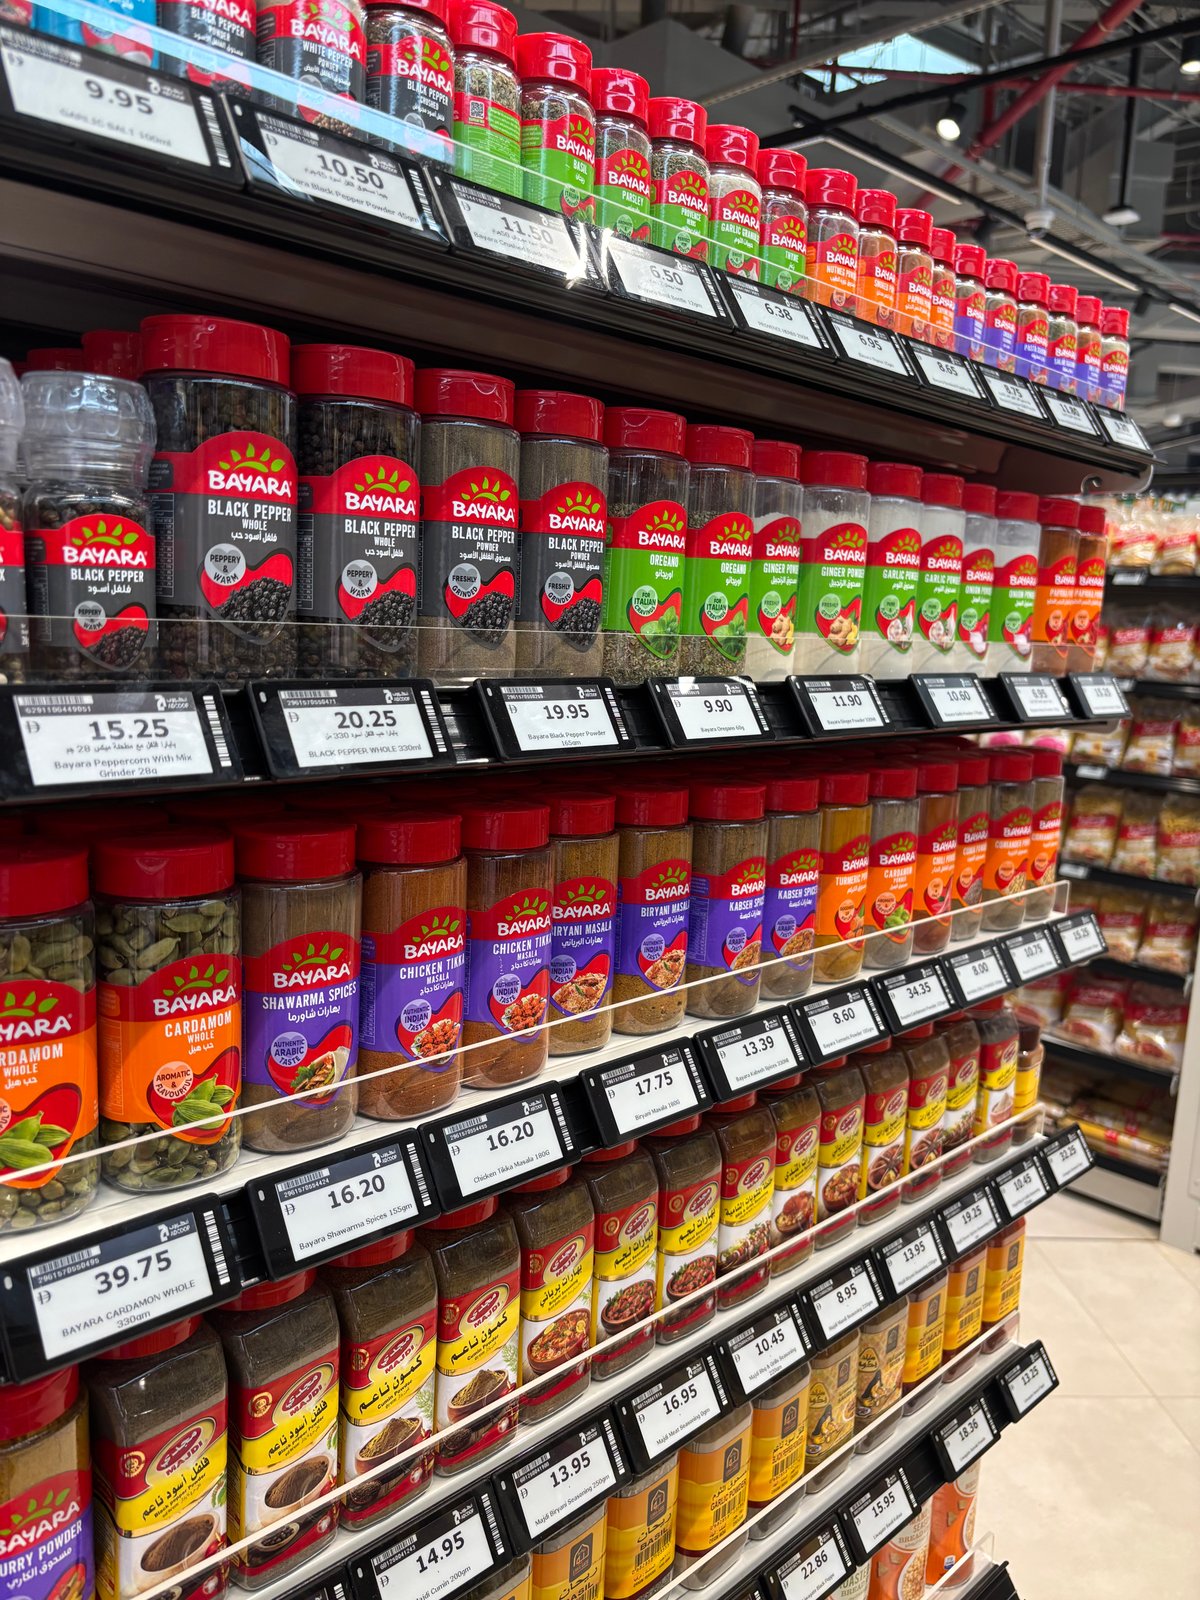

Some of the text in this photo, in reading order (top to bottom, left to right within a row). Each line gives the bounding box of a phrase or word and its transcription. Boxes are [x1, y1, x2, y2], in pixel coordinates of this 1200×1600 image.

[190, 7, 245, 38] BLACK PEPPER
[290, 19, 361, 59] BAYARA
[302, 40, 353, 69] WHITE PEPPER
[397, 59, 453, 96] BAYARA
[84, 79, 154, 116] 9.95
[407, 79, 449, 106] BLACK PEPPER
[317, 153, 385, 190] 10.50
[608, 171, 650, 196] BAYARA
[622, 190, 644, 207] PARSLEY
[668, 191, 709, 214] BAYARA
[720, 222, 741, 237] GARLIC
[771, 233, 808, 255] BAYARA
[649, 264, 684, 287] 6.50
[764, 302, 793, 321] 6.38
[858, 334, 883, 351] 6.95
[936, 361, 959, 377] 8.65
[207, 470, 292, 499] BAYARA
[208, 499, 292, 523] BLACK PEPPER
[344, 491, 416, 516] BAYARA
[452, 500, 516, 523] BAYARA
[241, 518, 268, 531] WHOLE
[344, 518, 416, 539] BLACK PEPPER
[548, 513, 605, 534] BAYARA
[374, 536, 396, 548] WHOLE
[452, 525, 515, 545] BLACK PEPPER
[638, 530, 686, 549] BAYARA
[476, 541, 499, 552] POWDER
[548, 537, 604, 554] BLACK PEPPER
[709, 541, 752, 558] BAYARA
[62, 545, 147, 567] BAYARA
[209, 553, 242, 564] PEPPERY
[570, 551, 591, 562] POWDER
[649, 553, 679, 568] OREGANO
[71, 568, 144, 583] BLACK PEPPER
[346, 569, 374, 579] PEPPERY
[720, 562, 747, 575] OREGANO
[212, 572, 240, 586] WARM
[452, 574, 477, 583] FRESHLY
[110, 585, 132, 594] فلفل
[349, 586, 372, 598] WARM
[452, 583, 479, 599] GRINDED
[631, 596, 657, 606] ITALIAN
[705, 603, 728, 612] ITALIAN
[77, 608, 102, 617] PEPPERY
[832, 694, 863, 708] 11.90
[946, 690, 971, 702] 10.60
[543, 703, 590, 720] 19.95
[703, 699, 733, 713] 9.90
[334, 710, 397, 729] 20.25
[88, 718, 170, 741] 15.25
[527, 730, 606, 743] Bayara Black Pepper Powder
[308, 743, 422, 758] BLACK PEPPER WHOLE 330ml
[54, 753, 193, 771] Bayara Peppercorn With Mix
[780, 870, 819, 886] BAYARA
[835, 873, 860, 886] TURMERIC
[883, 866, 913, 879] CARDAMOM
[645, 883, 690, 901] BAYARA
[552, 903, 612, 919] BAYARA
[640, 900, 690, 918] BIRYANI MASALA
[497, 914, 551, 936] BAYARA
[403, 933, 464, 959] BAYARA
[493, 940, 532, 955] CHICKEN
[517, 950, 538, 961] MASALA
[272, 963, 351, 988] BAYARA
[400, 961, 443, 980] CHICKEN
[426, 972, 450, 985] MASALA
[262, 981, 357, 1010] SHAWARMA SPICES
[495, 986, 519, 996] INDIAN
[906, 981, 932, 1000] 34.35
[153, 985, 237, 1016] BAYARA
[165, 1010, 232, 1038] CARDAMOM
[404, 1012, 429, 1024] INDIAN
[832, 1007, 856, 1025] 8.60
[187, 1030, 215, 1044] WHOLE
[273, 1039, 306, 1049] AUTHENTIC
[742, 1035, 775, 1057] 13.39
[274, 1046, 305, 1057] ARABIC
[3, 1063, 38, 1078] WHOLE
[279, 1057, 301, 1066] TASTE
[155, 1069, 191, 1082] AROMATIC
[635, 1071, 673, 1096] 17.75
[487, 1121, 535, 1152] 16.20
[328, 1174, 385, 1210] 16.20
[1013, 1174, 1032, 1192] 10.45
[299, 1202, 413, 1251] Bayara Shawarma Spices 155gm
[903, 1240, 926, 1263] 13.95
[94, 1249, 172, 1295] 39.75
[555, 1252, 578, 1278] MAJDI
[836, 1282, 858, 1305] 8.95
[62, 1279, 196, 1337] BAYARA CARDAMON WHOLE
[473, 1302, 501, 1328] MAJDI
[755, 1328, 785, 1357] 10.45
[384, 1344, 415, 1375] MAJDI
[1021, 1365, 1039, 1387] 13.25
[662, 1382, 699, 1416] 16.95
[656, 1434, 669, 1447] Majdi
[667, 1427, 679, 1439] Meat
[679, 1413, 700, 1431] Seasoning
[959, 1418, 980, 1442] 18.36
[165, 1440, 204, 1477] MAJDI
[549, 1450, 592, 1489] 13.95
[153, 1472, 207, 1519] Black pepper Powder
[534, 1473, 611, 1528] Majdi Biryani Seasoning 250gm
[710, 1479, 747, 1512] GARLIC POWDER
[871, 1491, 896, 1519] 15.95
[639, 1527, 673, 1550] BASIL
[0, 1519, 83, 1578] URRY POWDER
[416, 1530, 465, 1574] 14.95
[801, 1550, 829, 1580] 22.86
[429, 1578, 451, 1596] Cumin
[449, 1564, 472, 1584] 200gm
